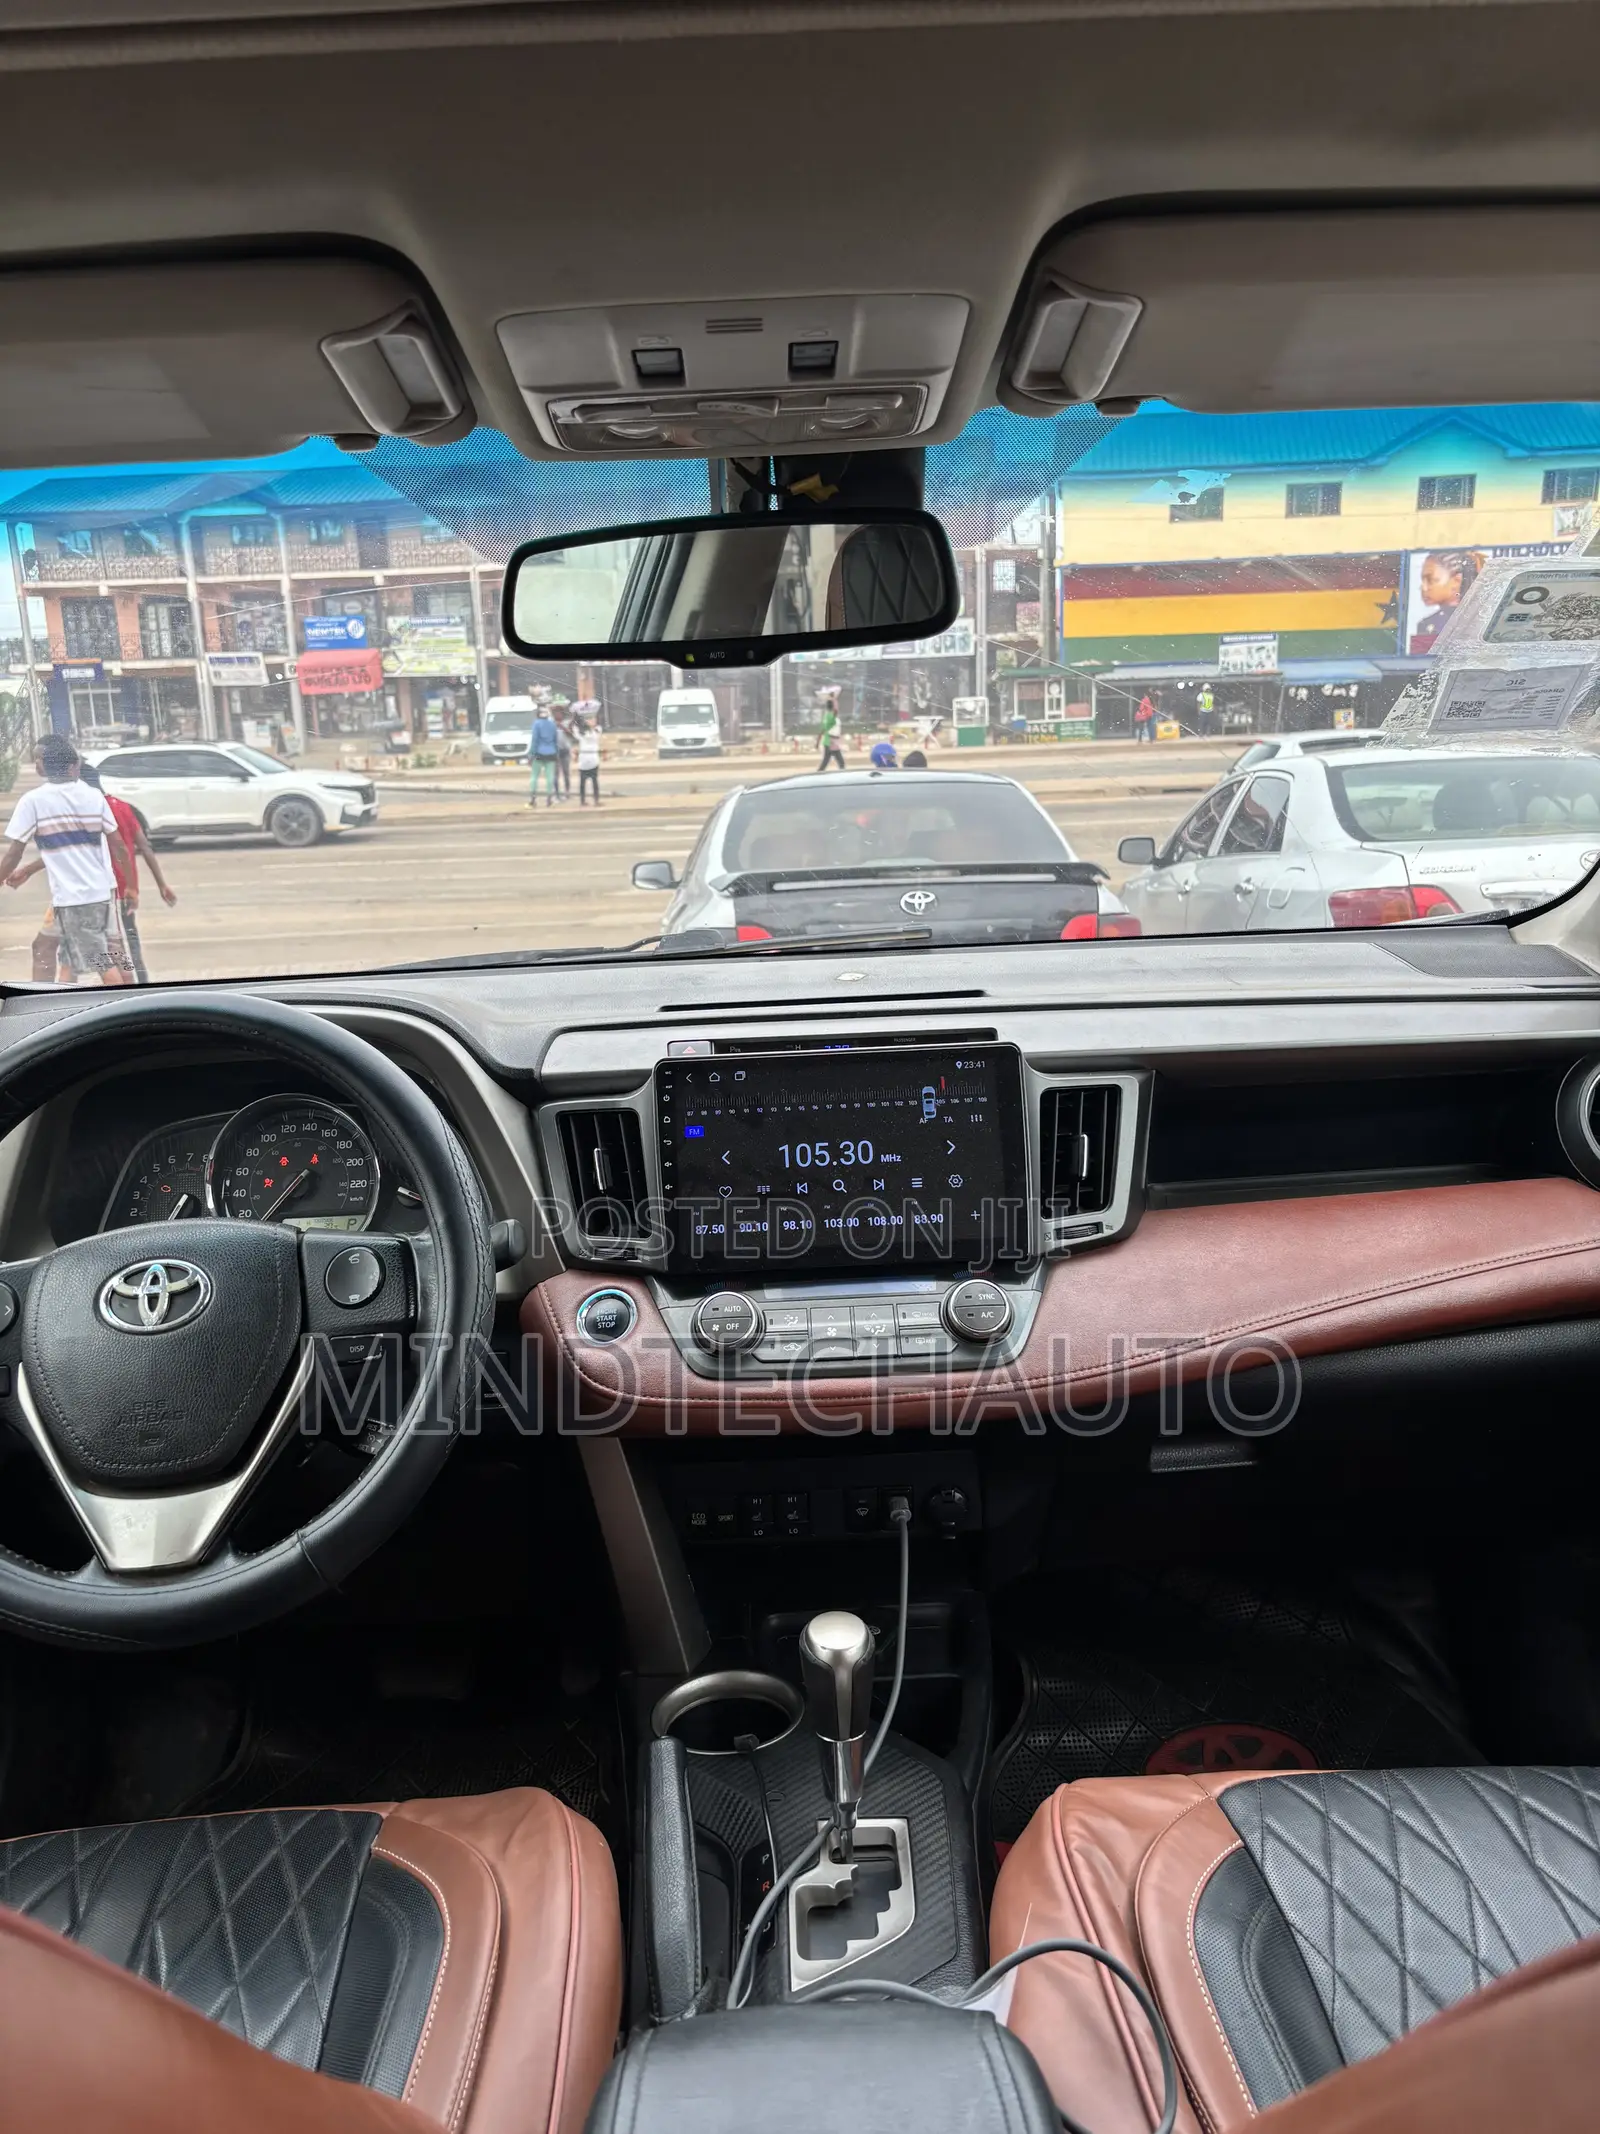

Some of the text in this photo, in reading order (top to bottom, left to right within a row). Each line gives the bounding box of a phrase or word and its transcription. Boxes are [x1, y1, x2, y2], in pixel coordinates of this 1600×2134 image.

[709, 651, 726, 659] AUTO
[964, 1060, 986, 1069] 23:41
[281, 1124, 297, 1134] 120
[302, 1122, 318, 1132] 140
[261, 1133, 277, 1143] 100
[321, 1129, 338, 1138] 160
[336, 1140, 353, 1149] 180
[186, 1152, 194, 1162] 7
[246, 1148, 260, 1157] 80
[778, 1140, 902, 1168] 105.30 MHz
[168, 1155, 176, 1164] 6
[346, 1158, 364, 1167] 200
[153, 1164, 160, 1173] 5
[235, 1167, 249, 1176] 60
[140, 1176, 148, 1184] 4
[350, 1179, 367, 1188] 220
[133, 1191, 140, 1200] 3
[233, 1189, 247, 1198] 40
[129, 1208, 138, 1217] 2
[238, 1209, 252, 1218] 20
[823, 1217, 860, 1229] 103.00
[867, 1215, 903, 1227] 108.00
[914, 1213, 944, 1225] 88.90
[347, 1218, 357, 1231] P
[695, 1223, 725, 1235] 87.50
[739, 1222, 769, 1233] 90.10
[782, 1219, 812, 1231] 98.10
[978, 1293, 996, 1301] SYNC
[724, 1305, 742, 1313] AUTO
[596, 1314, 617, 1322] START
[598, 1321, 616, 1329] STOP
[726, 1322, 740, 1331] OFF
[349, 1345, 365, 1353] DISP
[762, 1853, 770, 1864] P
[762, 1880, 770, 1892] R
